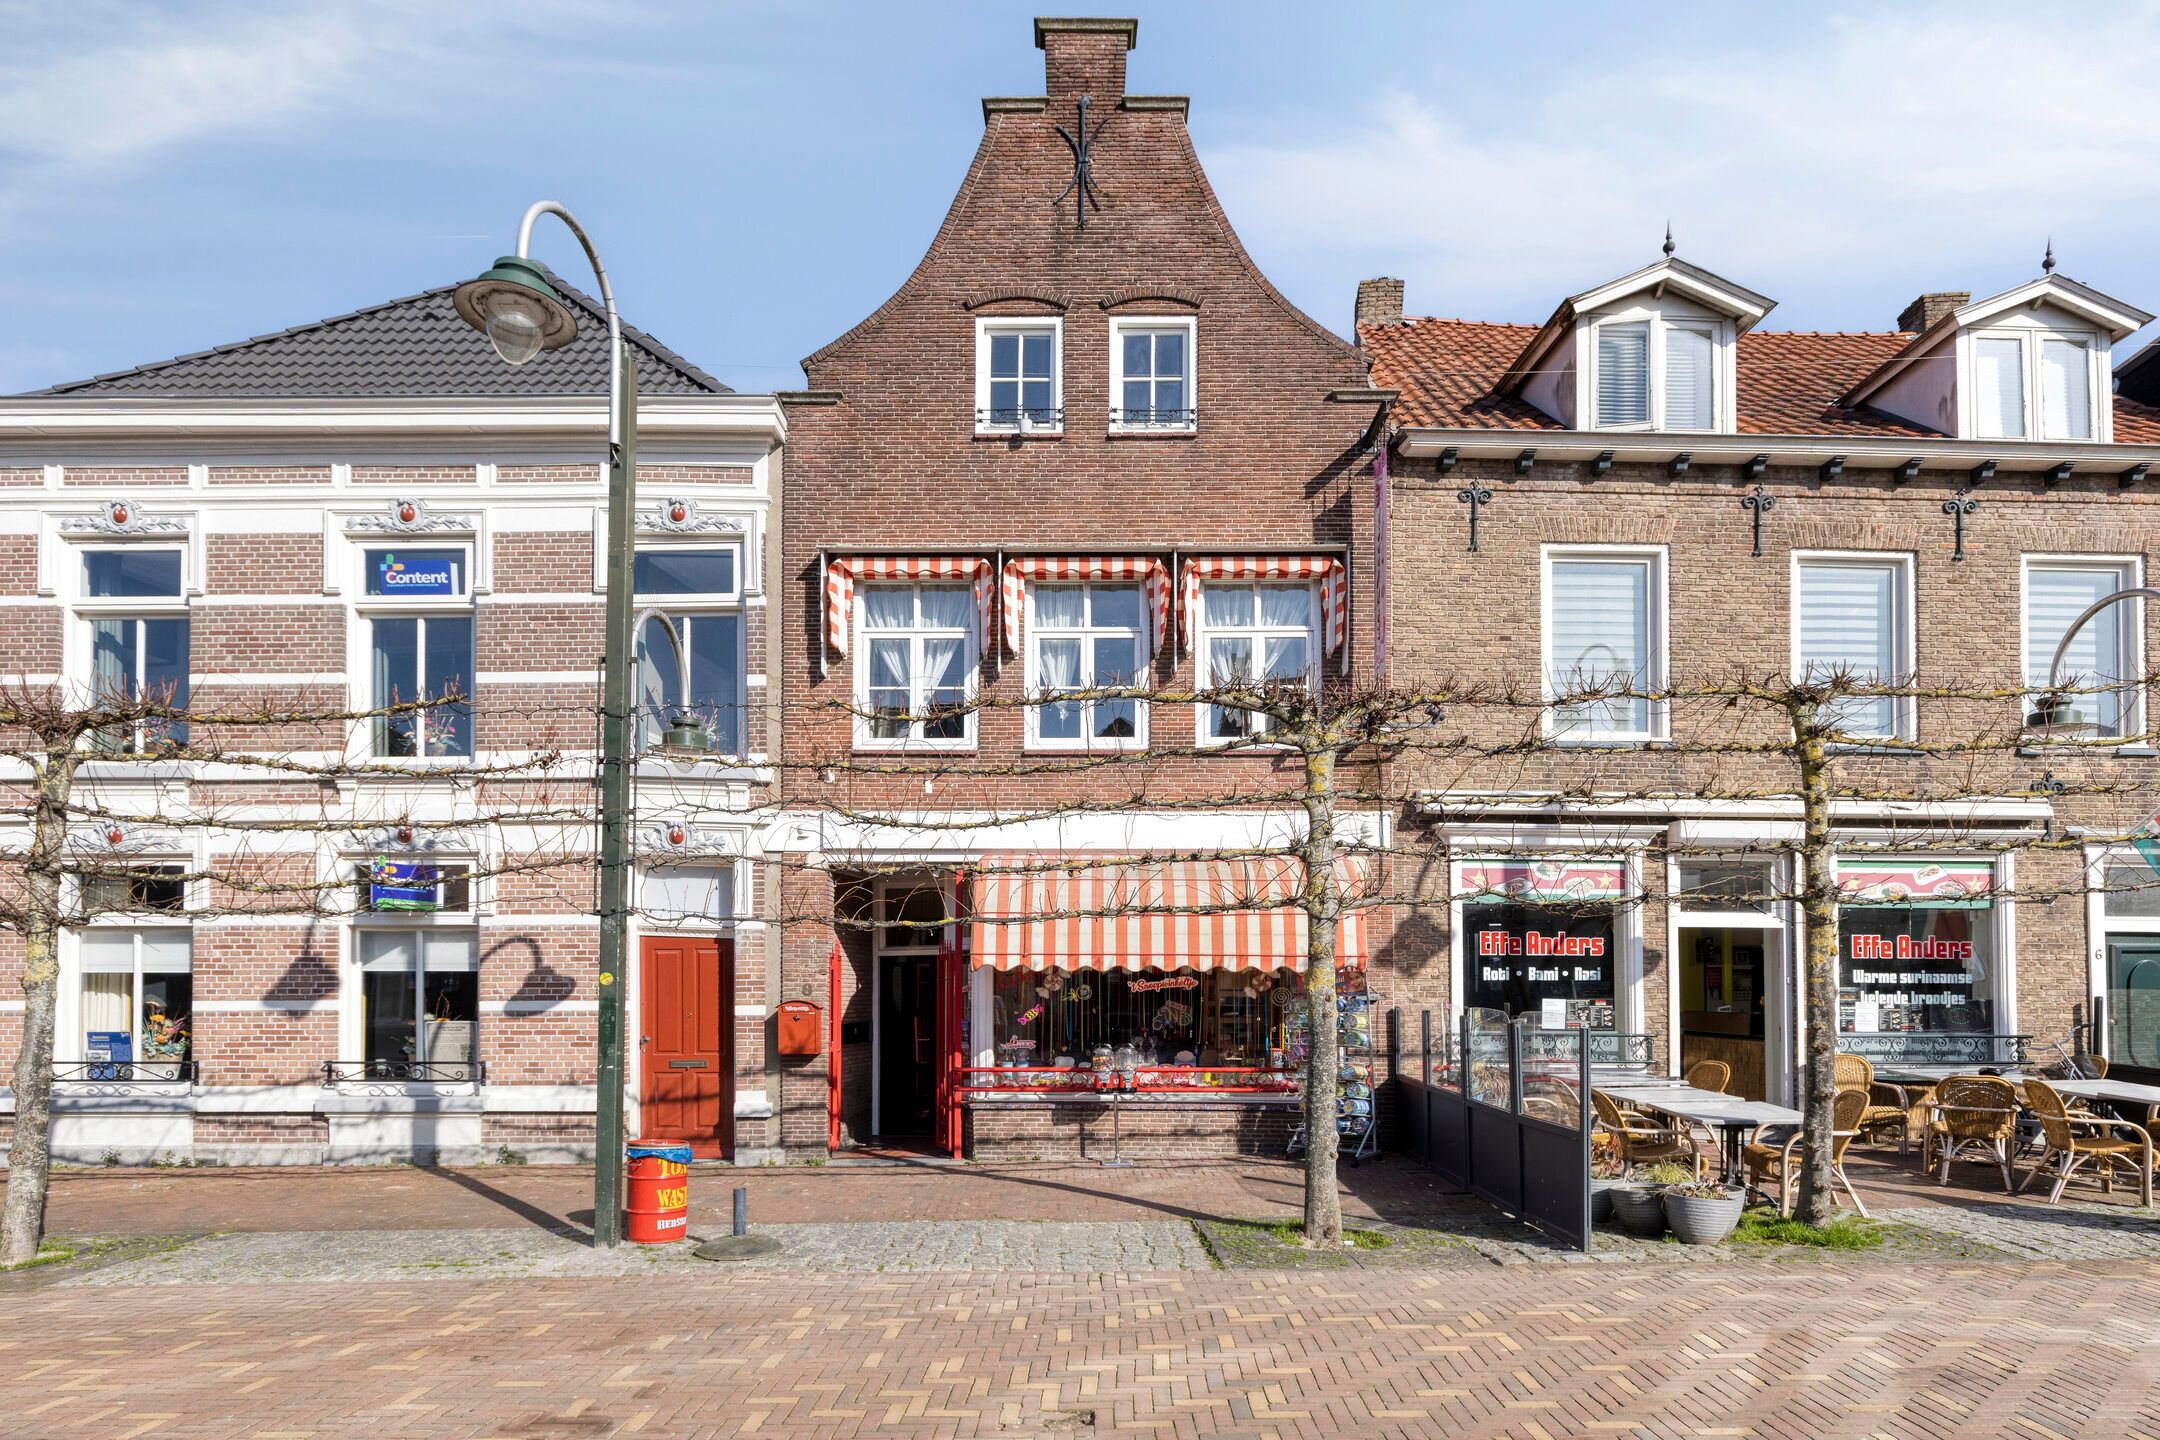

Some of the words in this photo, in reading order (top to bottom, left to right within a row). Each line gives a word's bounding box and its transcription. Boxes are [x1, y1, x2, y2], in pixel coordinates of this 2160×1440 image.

[385, 572, 449, 584] Content
[1479, 930, 1522, 956] Effe
[1526, 930, 1604, 956] Anders
[1851, 934, 1893, 959] Effe
[1897, 934, 1973, 959] Anders
[2095, 949, 2103, 960] 6
[1483, 966, 1510, 981] Roti
[1528, 966, 1559, 981] Bami
[1574, 966, 1602, 981] Nasi
[1852, 969, 1897, 984] Warme
[1899, 969, 1973, 984] surinaamse
[1860, 990, 1909, 1009] belegde
[1911, 990, 1966, 1008] broodjes
